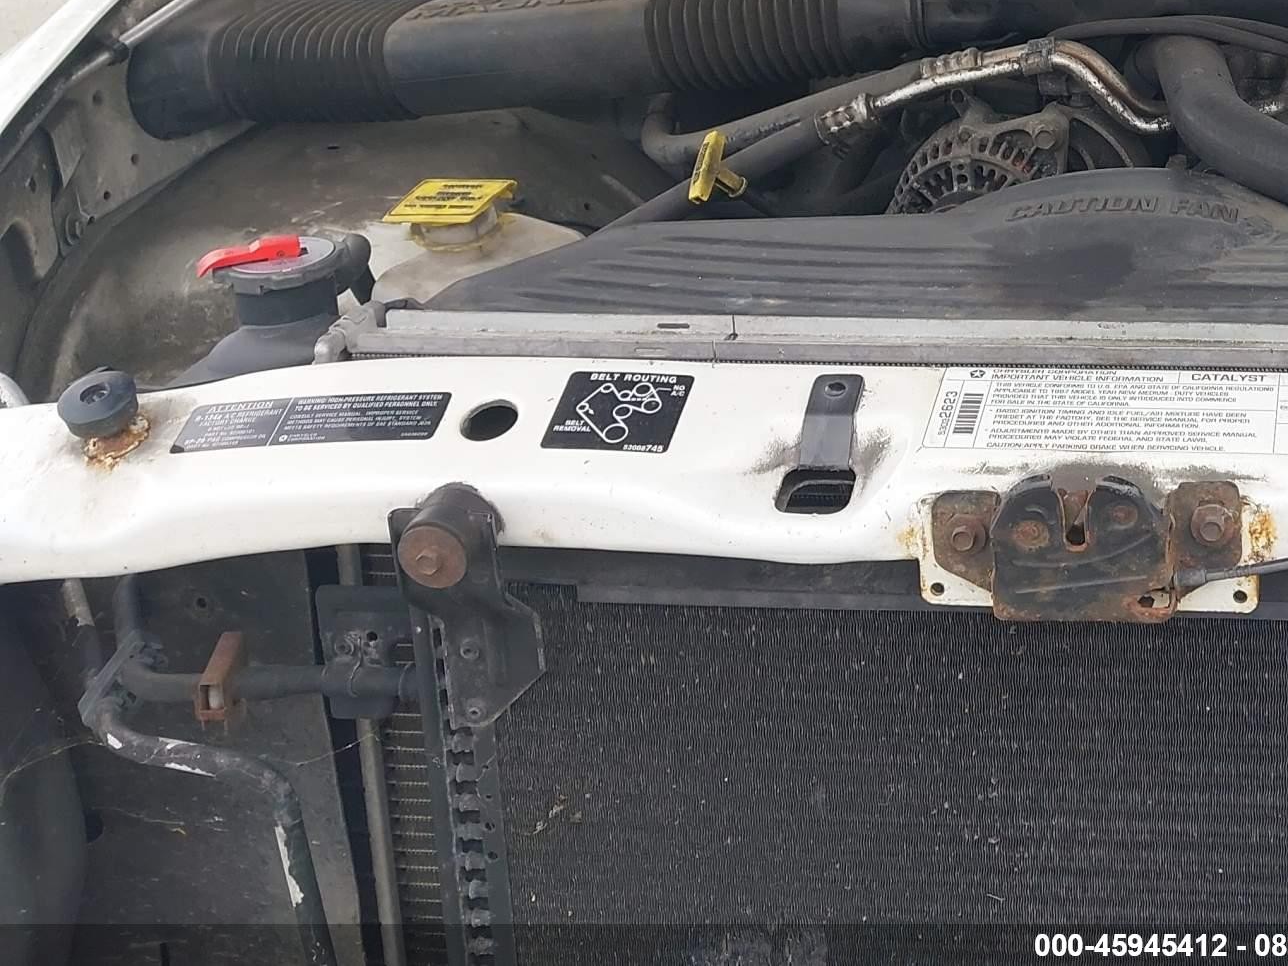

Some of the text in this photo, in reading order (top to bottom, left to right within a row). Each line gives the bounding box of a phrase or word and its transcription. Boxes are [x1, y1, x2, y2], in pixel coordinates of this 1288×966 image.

[1005, 196, 1239, 223] CAUTION FAN
[590, 373, 677, 384] BELT ROUTING
[1191, 373, 1267, 382] CATALYST
[207, 401, 274, 414] ATTENTION
